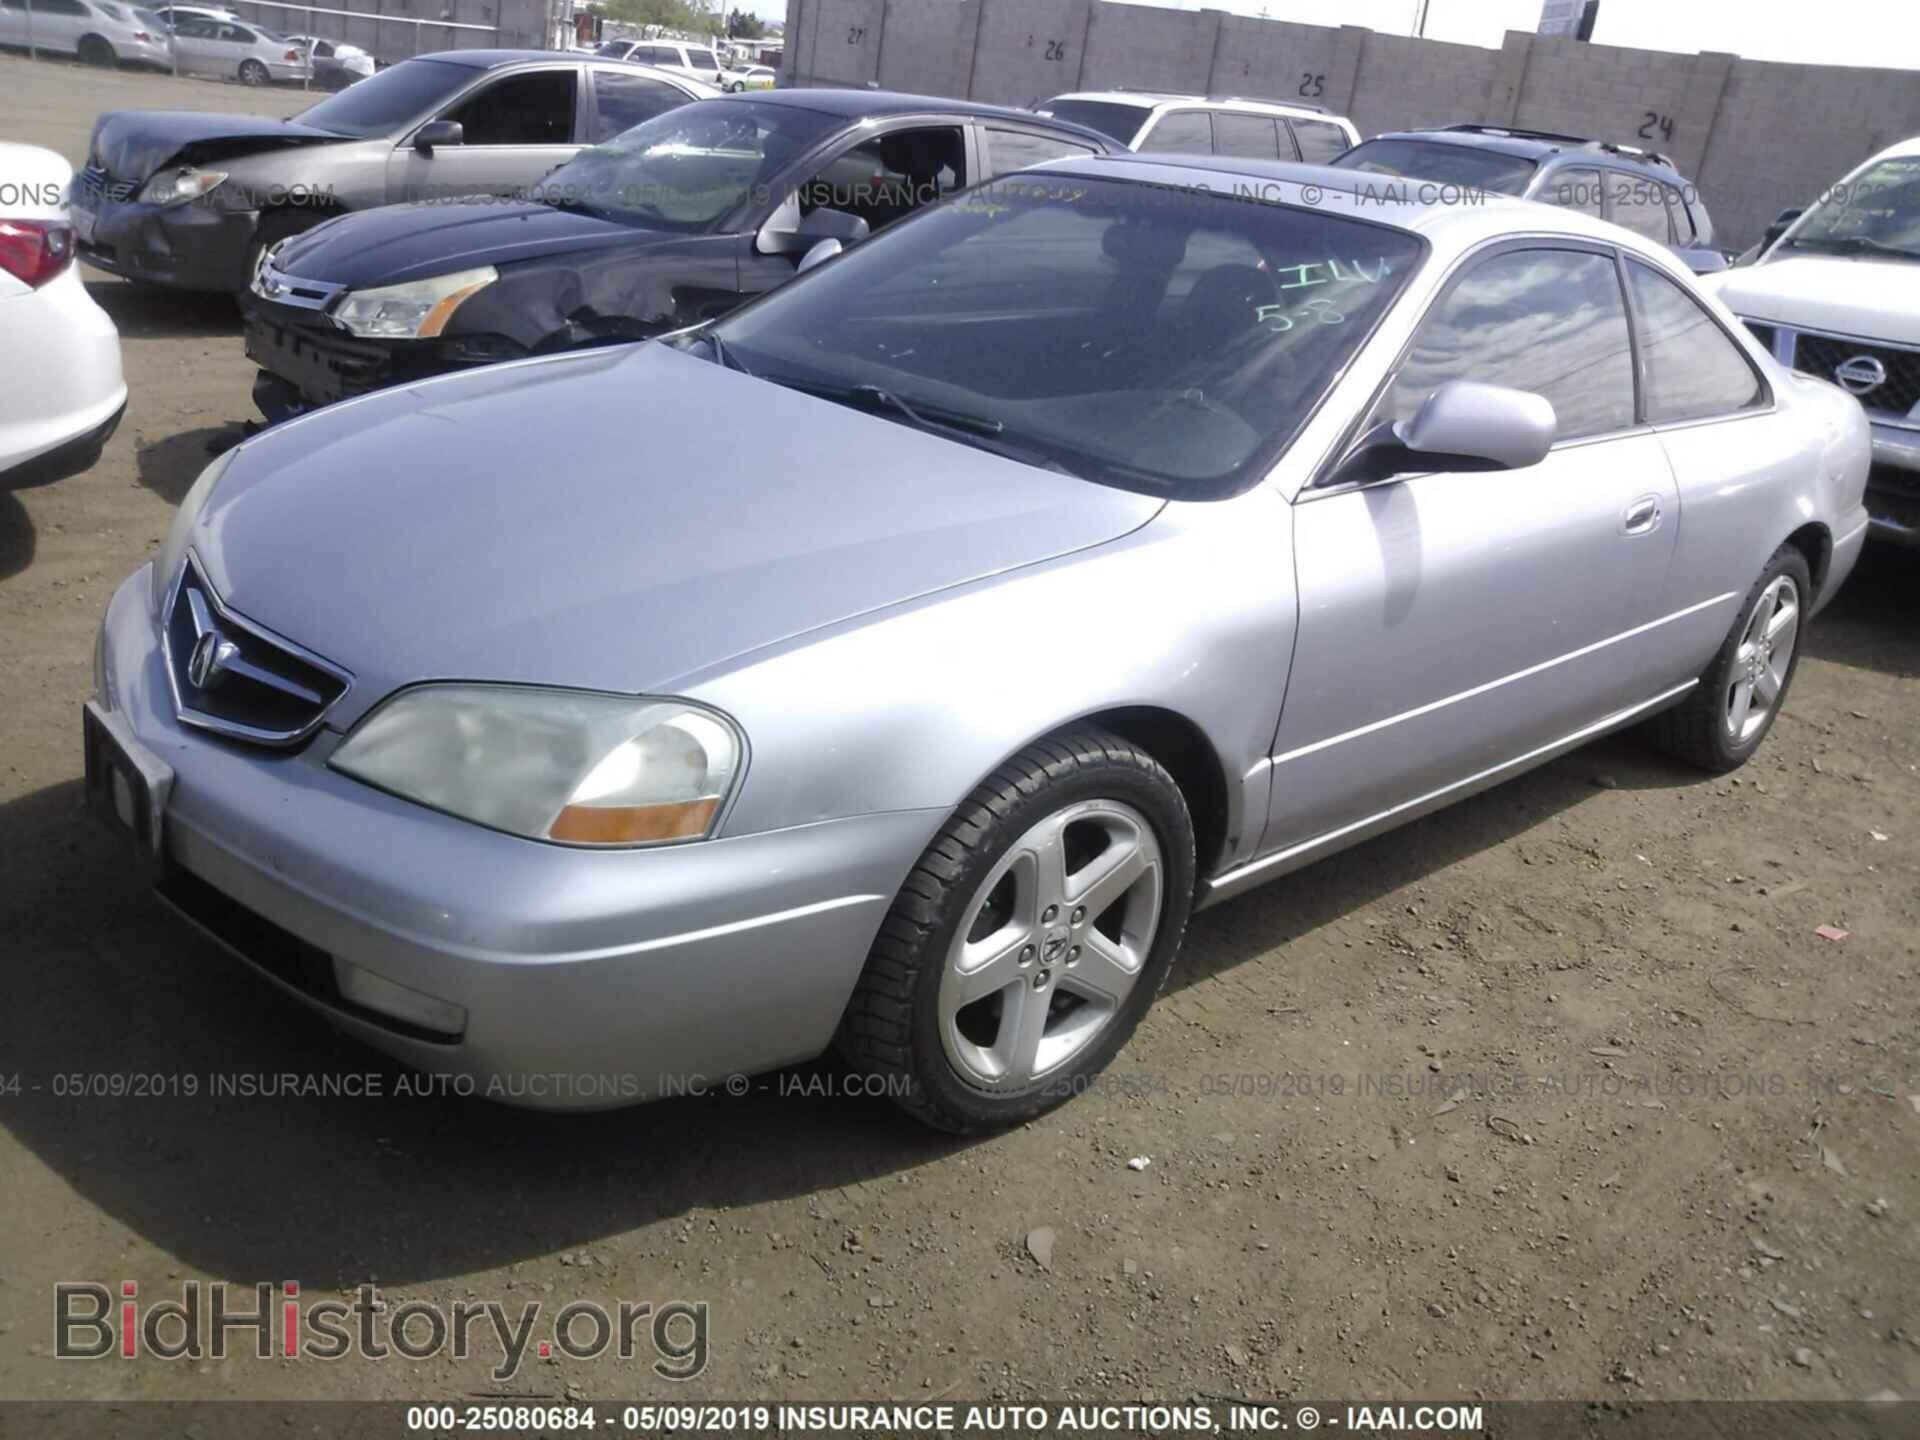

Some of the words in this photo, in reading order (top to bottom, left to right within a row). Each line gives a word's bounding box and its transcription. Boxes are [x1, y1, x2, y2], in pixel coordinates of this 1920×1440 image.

[1044, 40, 1065, 62] 26
[1299, 73, 1326, 98] 25
[1637, 111, 1674, 142] 24
[1256, 299, 1345, 332] 5-8
